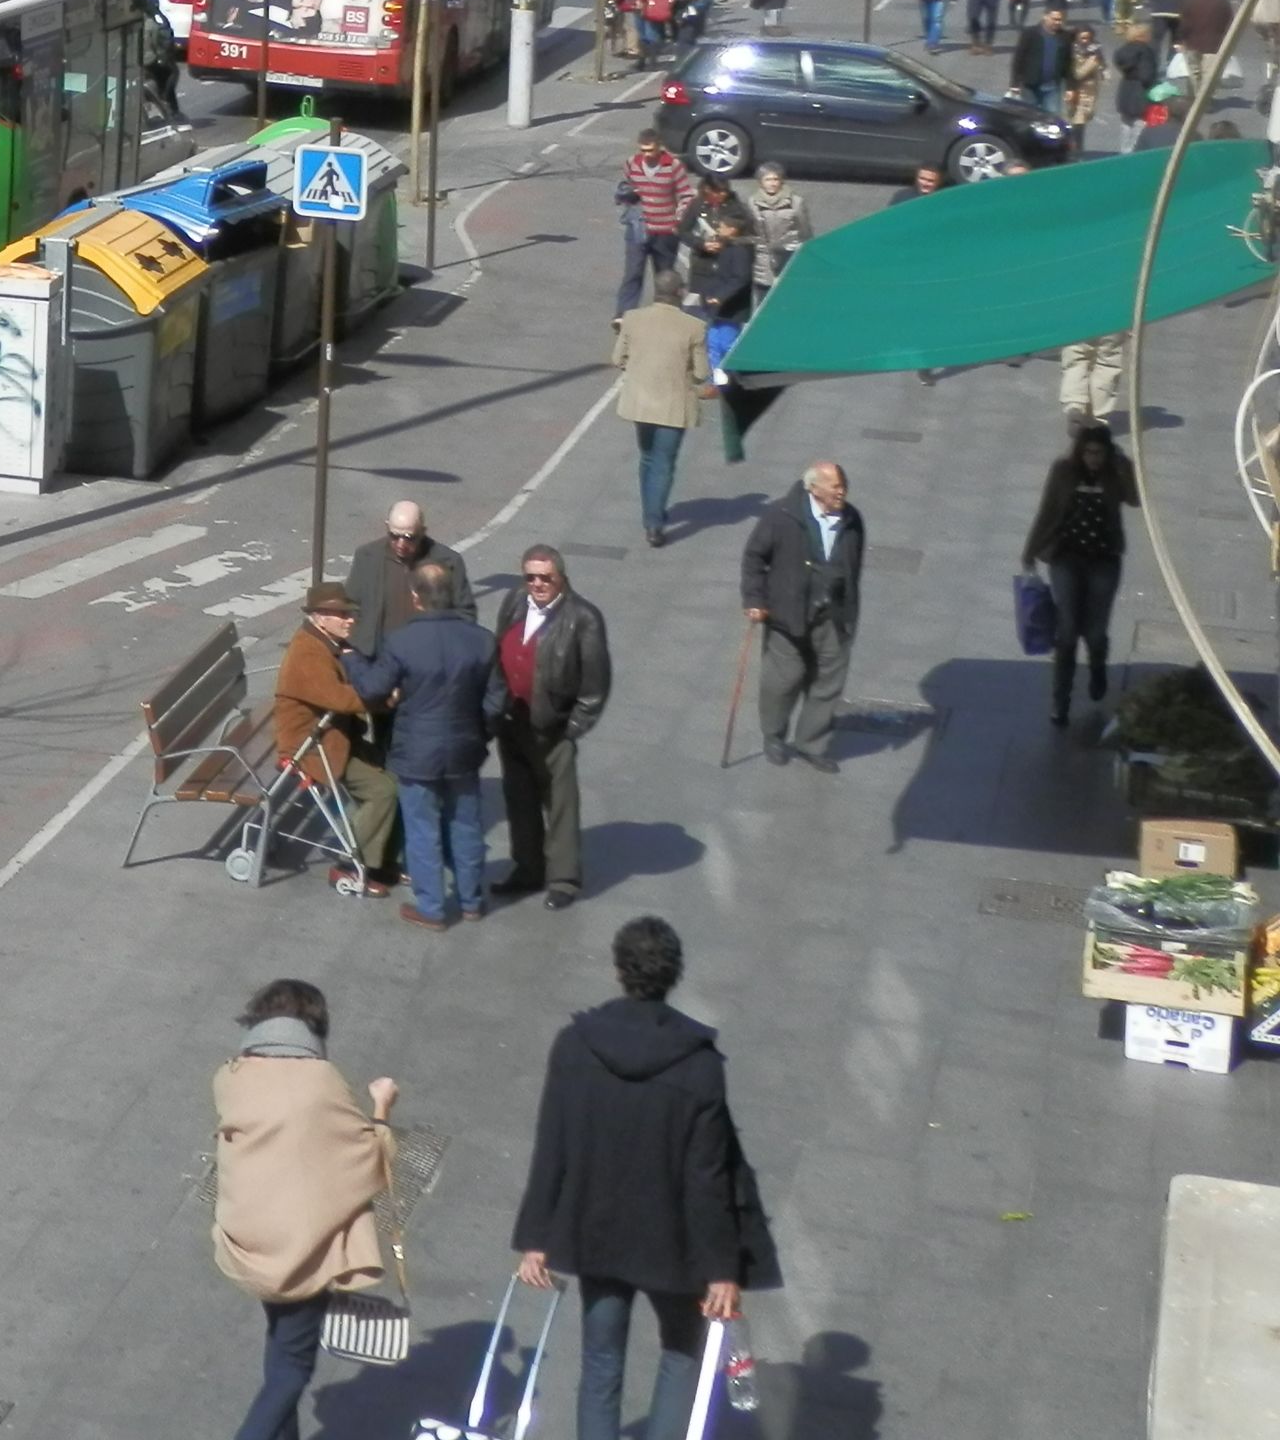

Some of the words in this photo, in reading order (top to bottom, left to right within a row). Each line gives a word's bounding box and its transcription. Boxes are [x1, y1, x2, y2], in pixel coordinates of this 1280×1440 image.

[345, 10, 366, 24] BS
[220, 43, 248, 59] 391
[1145, 1006, 1216, 1030] Canario
